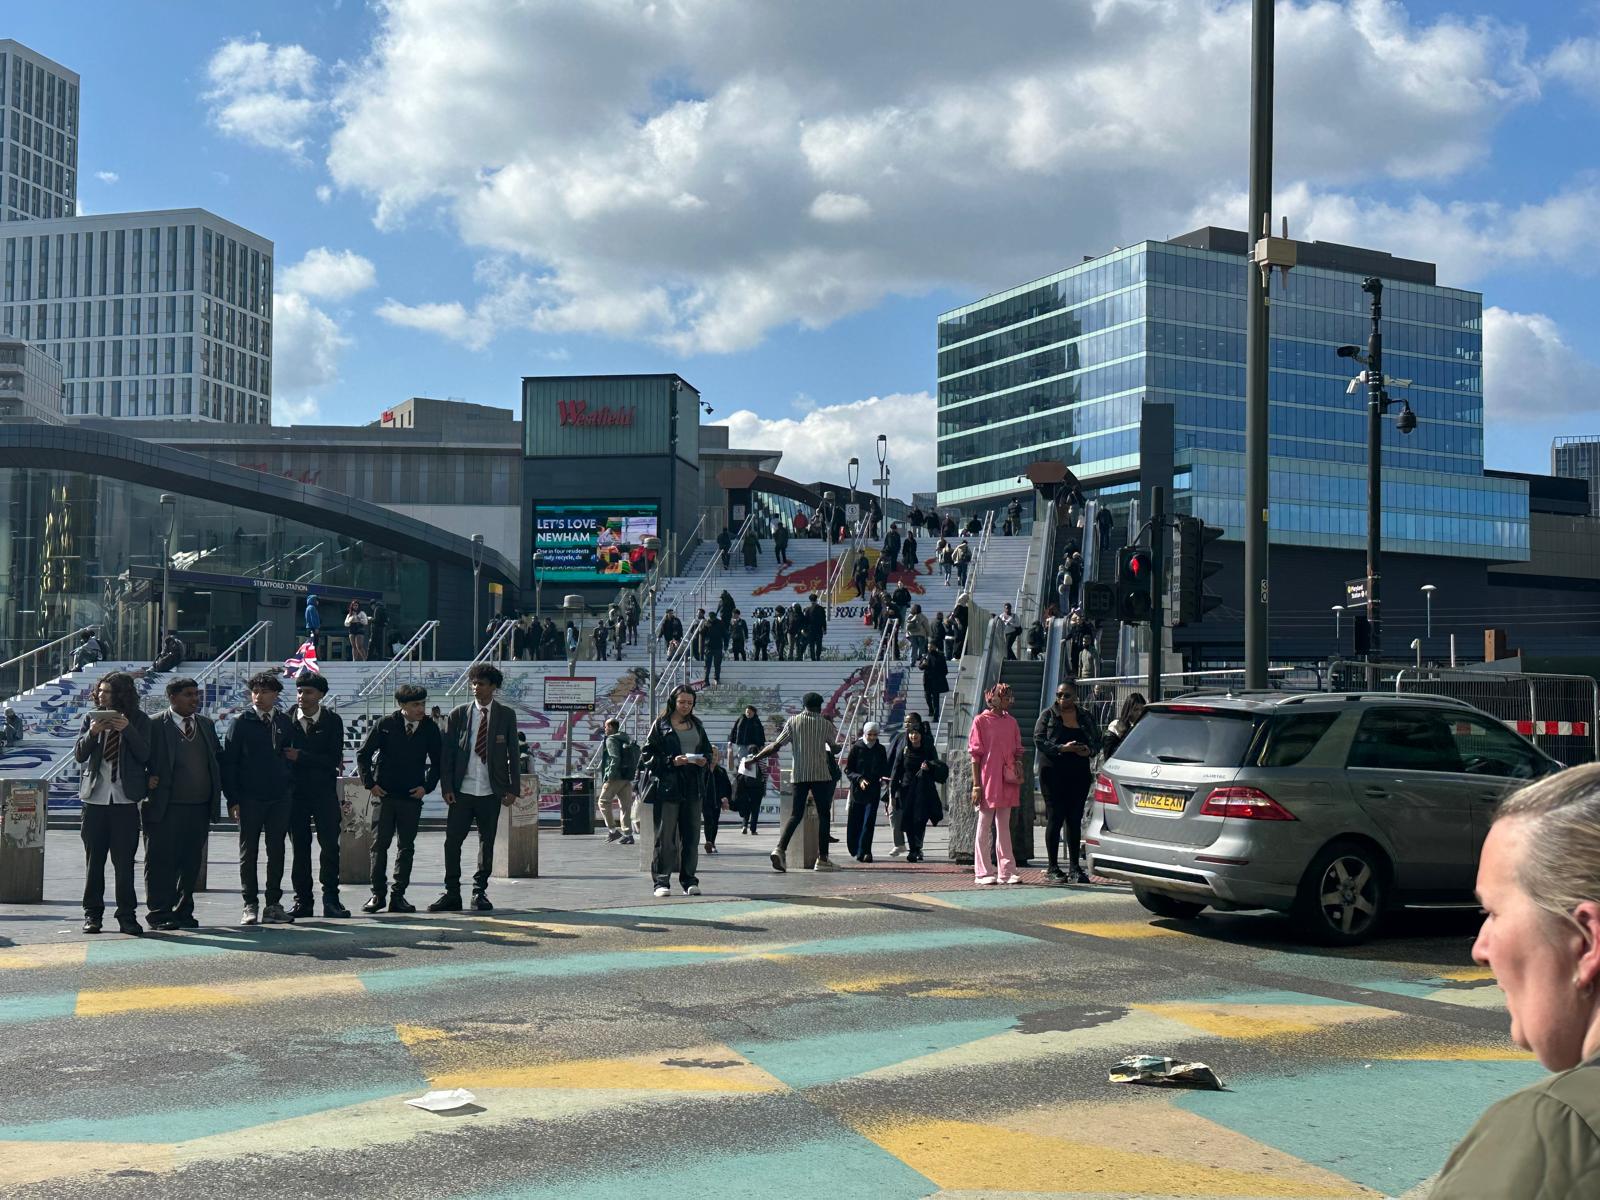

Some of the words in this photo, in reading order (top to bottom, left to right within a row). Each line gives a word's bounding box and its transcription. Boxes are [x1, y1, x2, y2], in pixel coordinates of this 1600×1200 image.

[557, 400, 636, 427] Westfield
[537, 519, 565, 529] LET'S
[567, 519, 597, 529] LOVE
[537, 532, 590, 542] NEWHAM
[253, 580, 285, 589] STRATFORD
[286, 583, 308, 591] STATION
